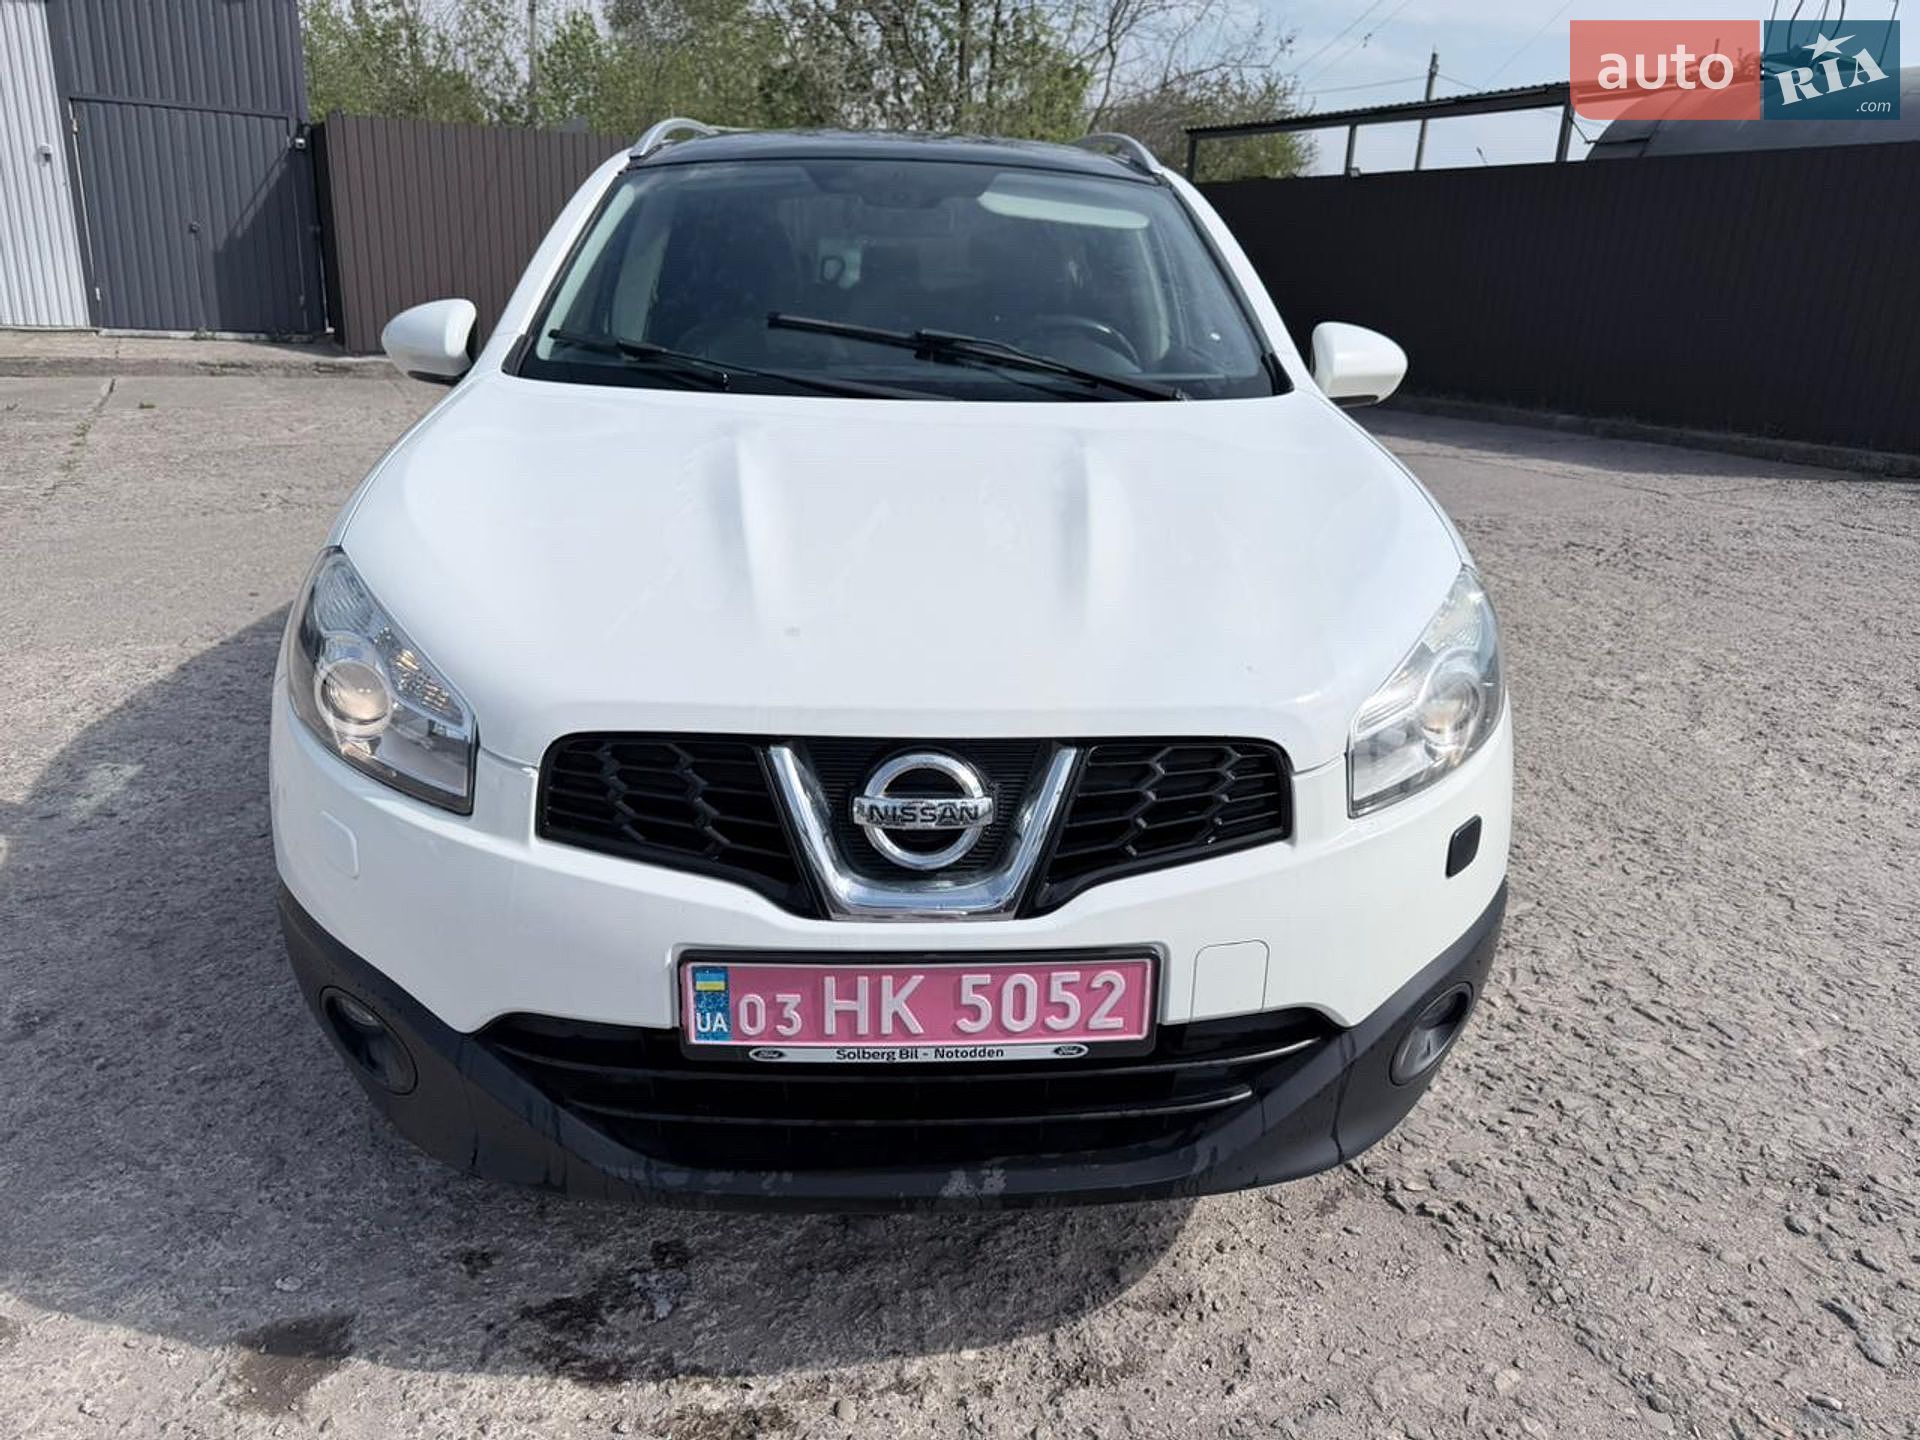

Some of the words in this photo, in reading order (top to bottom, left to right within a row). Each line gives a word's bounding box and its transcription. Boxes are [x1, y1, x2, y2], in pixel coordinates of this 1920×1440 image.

[868, 803, 979, 823] NISSAN
[738, 993, 802, 1036] 03
[823, 975, 924, 1035] HK
[955, 970, 1126, 1033] 5052
[696, 1012, 728, 1032] UA
[836, 1047, 897, 1061] Solberg
[899, 1047, 919, 1060] Bil
[934, 1046, 1004, 1059] Notodden
